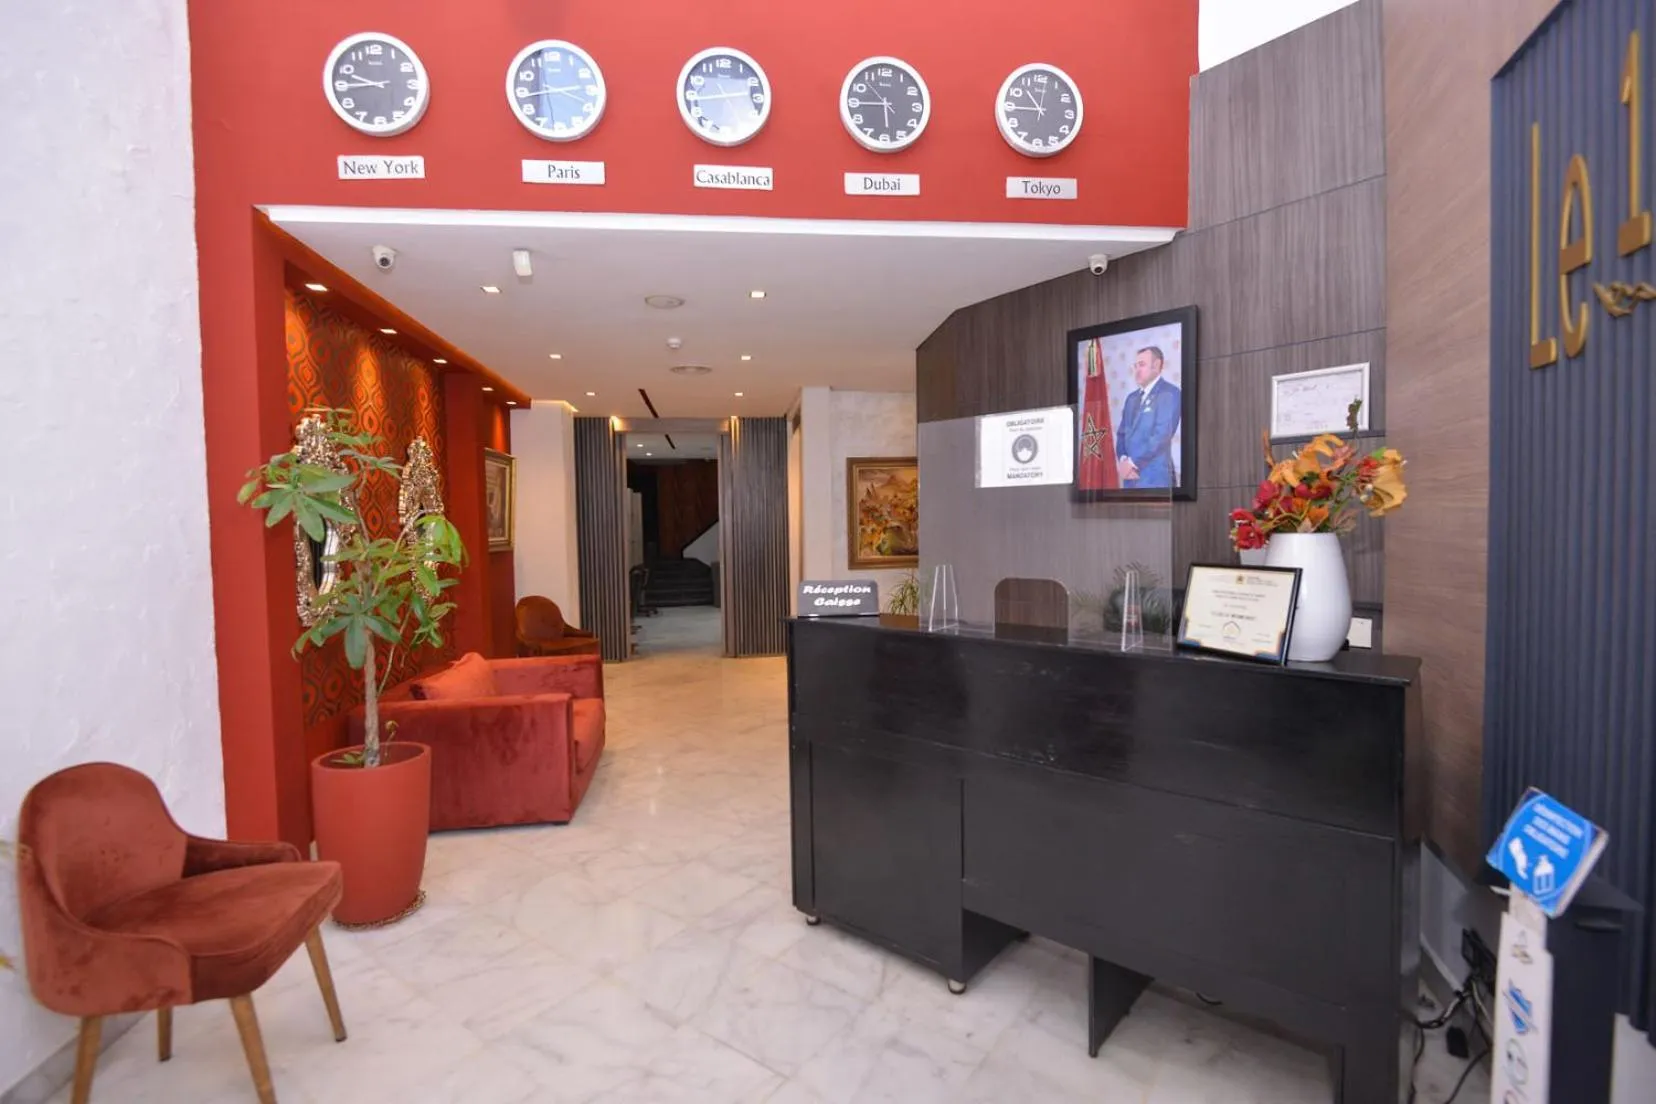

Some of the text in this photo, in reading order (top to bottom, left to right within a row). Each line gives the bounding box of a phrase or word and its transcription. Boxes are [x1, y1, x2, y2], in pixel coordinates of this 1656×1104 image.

[365, 44, 383, 55] 12
[391, 48, 396, 60] 1
[351, 51, 363, 61] 11
[339, 64, 354, 75] 10
[400, 62, 414, 73] 2
[877, 67, 893, 77] 12
[865, 71, 875, 81] 11
[900, 73, 904, 83] 1
[1034, 74, 1049, 84] 12
[334, 80, 349, 92] 9
[406, 79, 419, 90] 3
[1021, 77, 1031, 87] 11
[1054, 81, 1058, 89] 1
[852, 83, 867, 93] 10
[906, 86, 918, 96] 2
[1009, 87, 1023, 98] 10
[342, 98, 355, 109] 8
[403, 96, 417, 107] 4
[848, 97, 860, 108] 9
[1060, 93, 1071, 103] 2
[911, 102, 923, 113] 3
[1004, 101, 1016, 112] 9
[355, 111, 368, 123] 7
[392, 111, 405, 121] 5
[853, 113, 864, 124] 8
[1064, 109, 1074, 120] 3
[373, 116, 387, 125] 6
[906, 118, 918, 129] 4
[1008, 117, 1019, 128] 8
[863, 127, 874, 137] 7
[896, 130, 907, 140] 5
[1059, 125, 1070, 135] 4
[879, 133, 891, 143] 6
[1017, 131, 1029, 141] 7
[1048, 135, 1059, 146] 5
[1032, 138, 1043, 147] 6
[343, 160, 419, 175] New York
[547, 164, 581, 179] Paris
[696, 169, 770, 186] Casablanca
[863, 177, 901, 191] Dubai
[1022, 180, 1061, 196] Tokyo
[1529, 120, 1592, 370] Le
[803, 584, 871, 595] Réception
